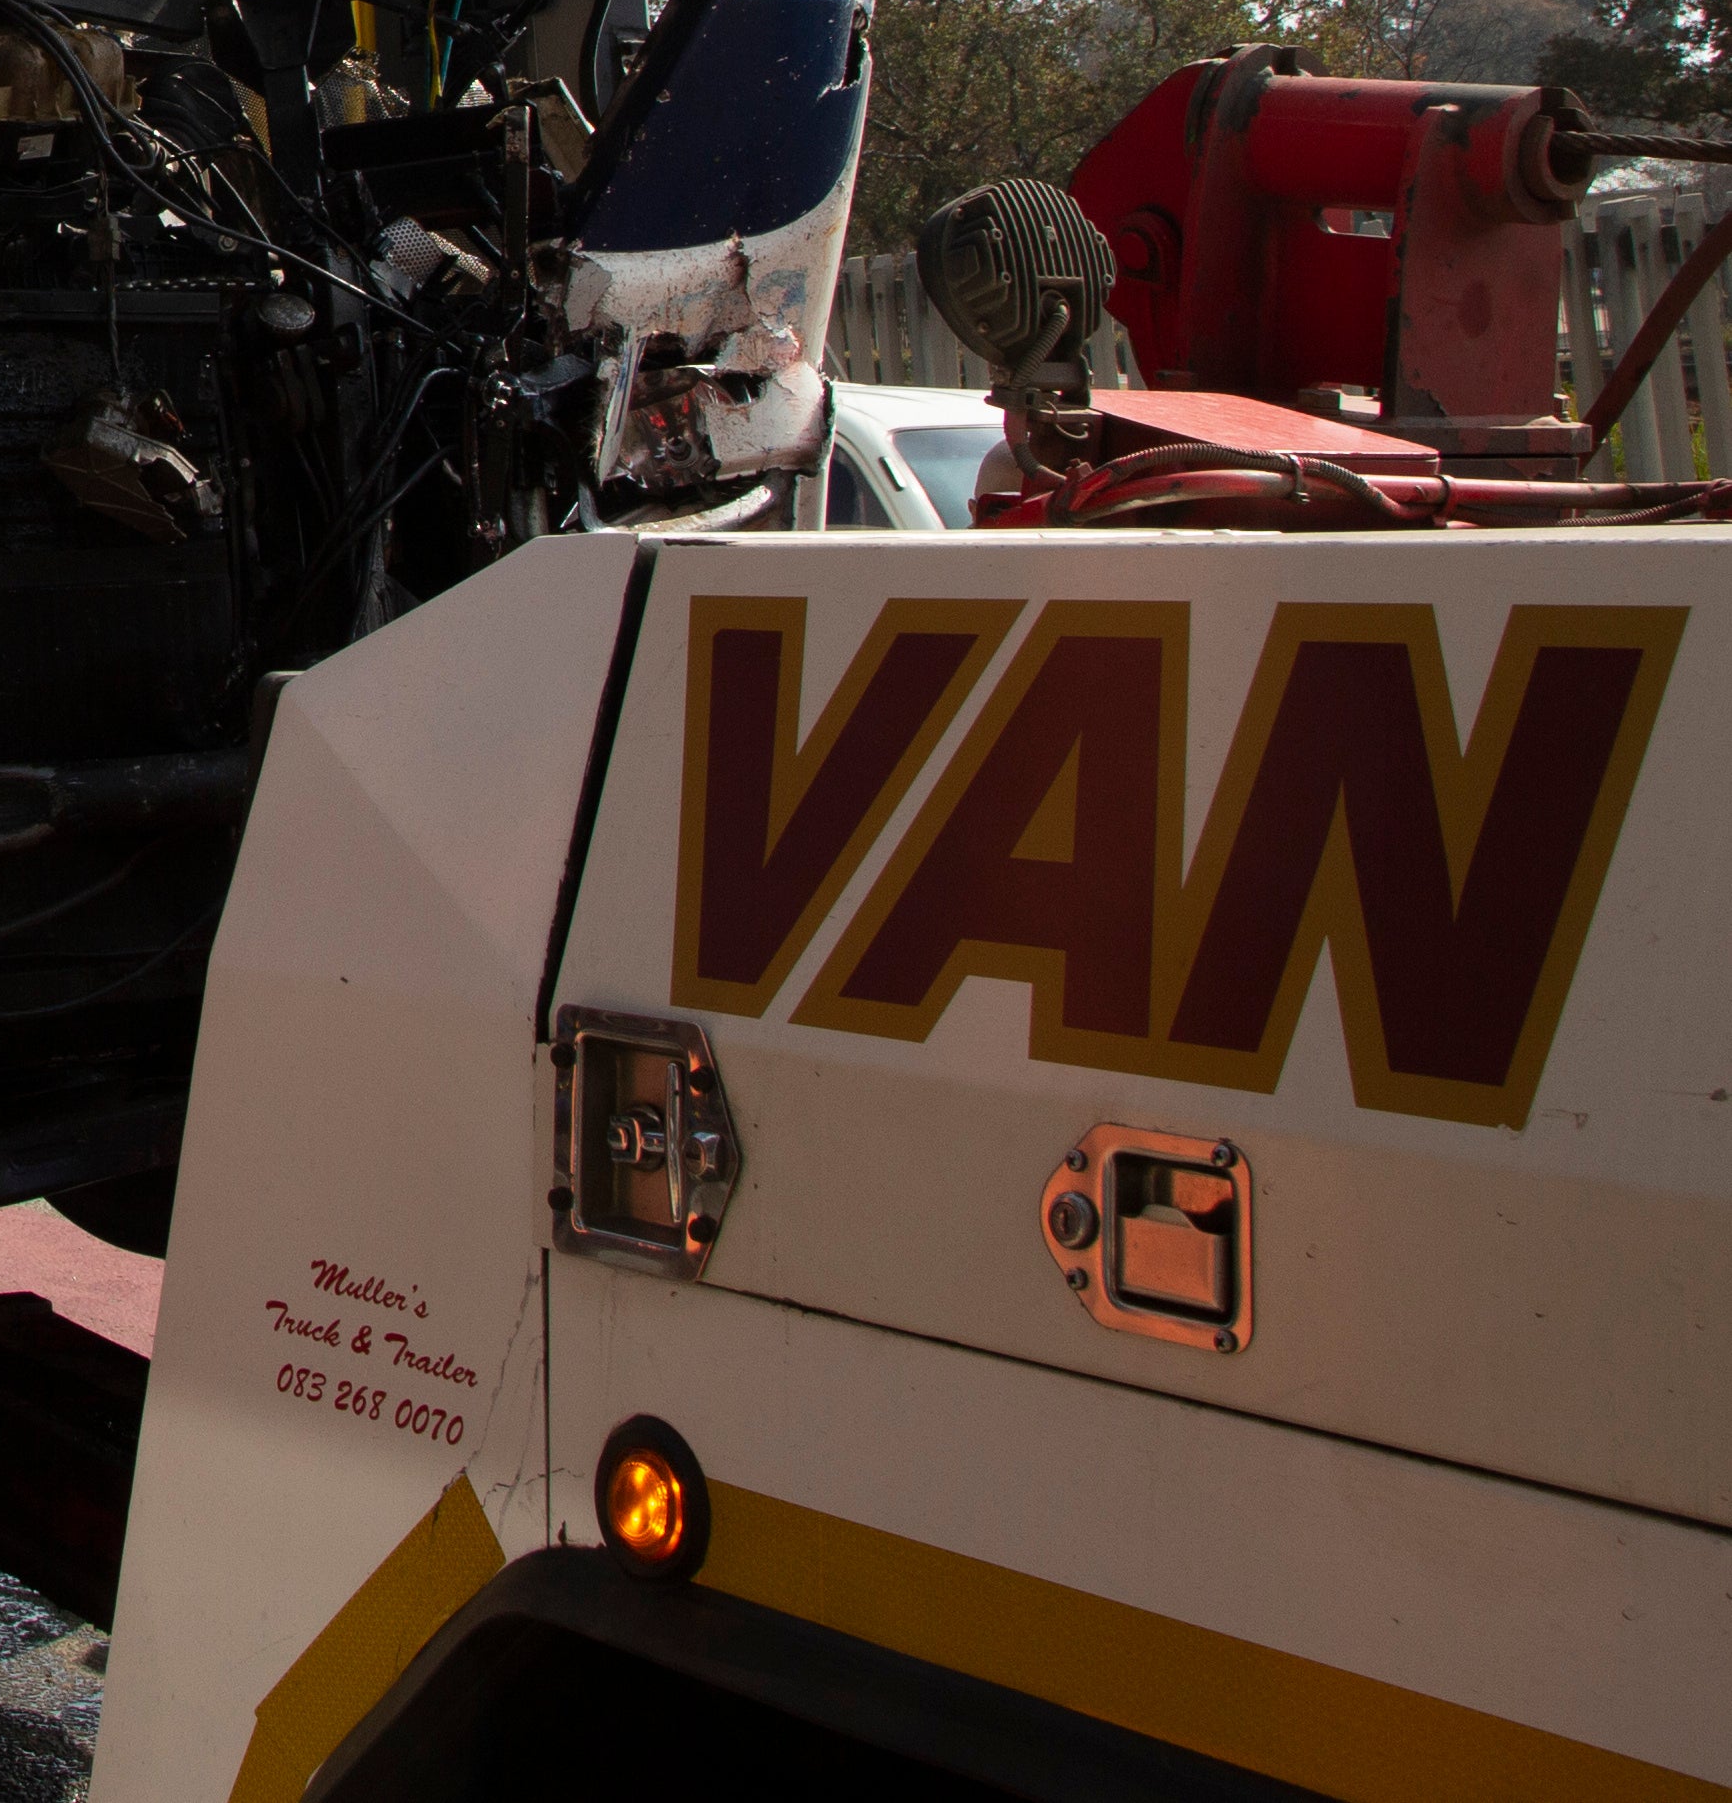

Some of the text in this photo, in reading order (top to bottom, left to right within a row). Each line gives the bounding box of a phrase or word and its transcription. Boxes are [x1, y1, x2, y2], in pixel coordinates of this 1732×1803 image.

[669, 595, 1692, 1132] VAN
[310, 1259, 429, 1318] Muller's
[265, 1300, 478, 1388] Truck & Trailer
[276, 1363, 464, 1446] 083 268 0070
